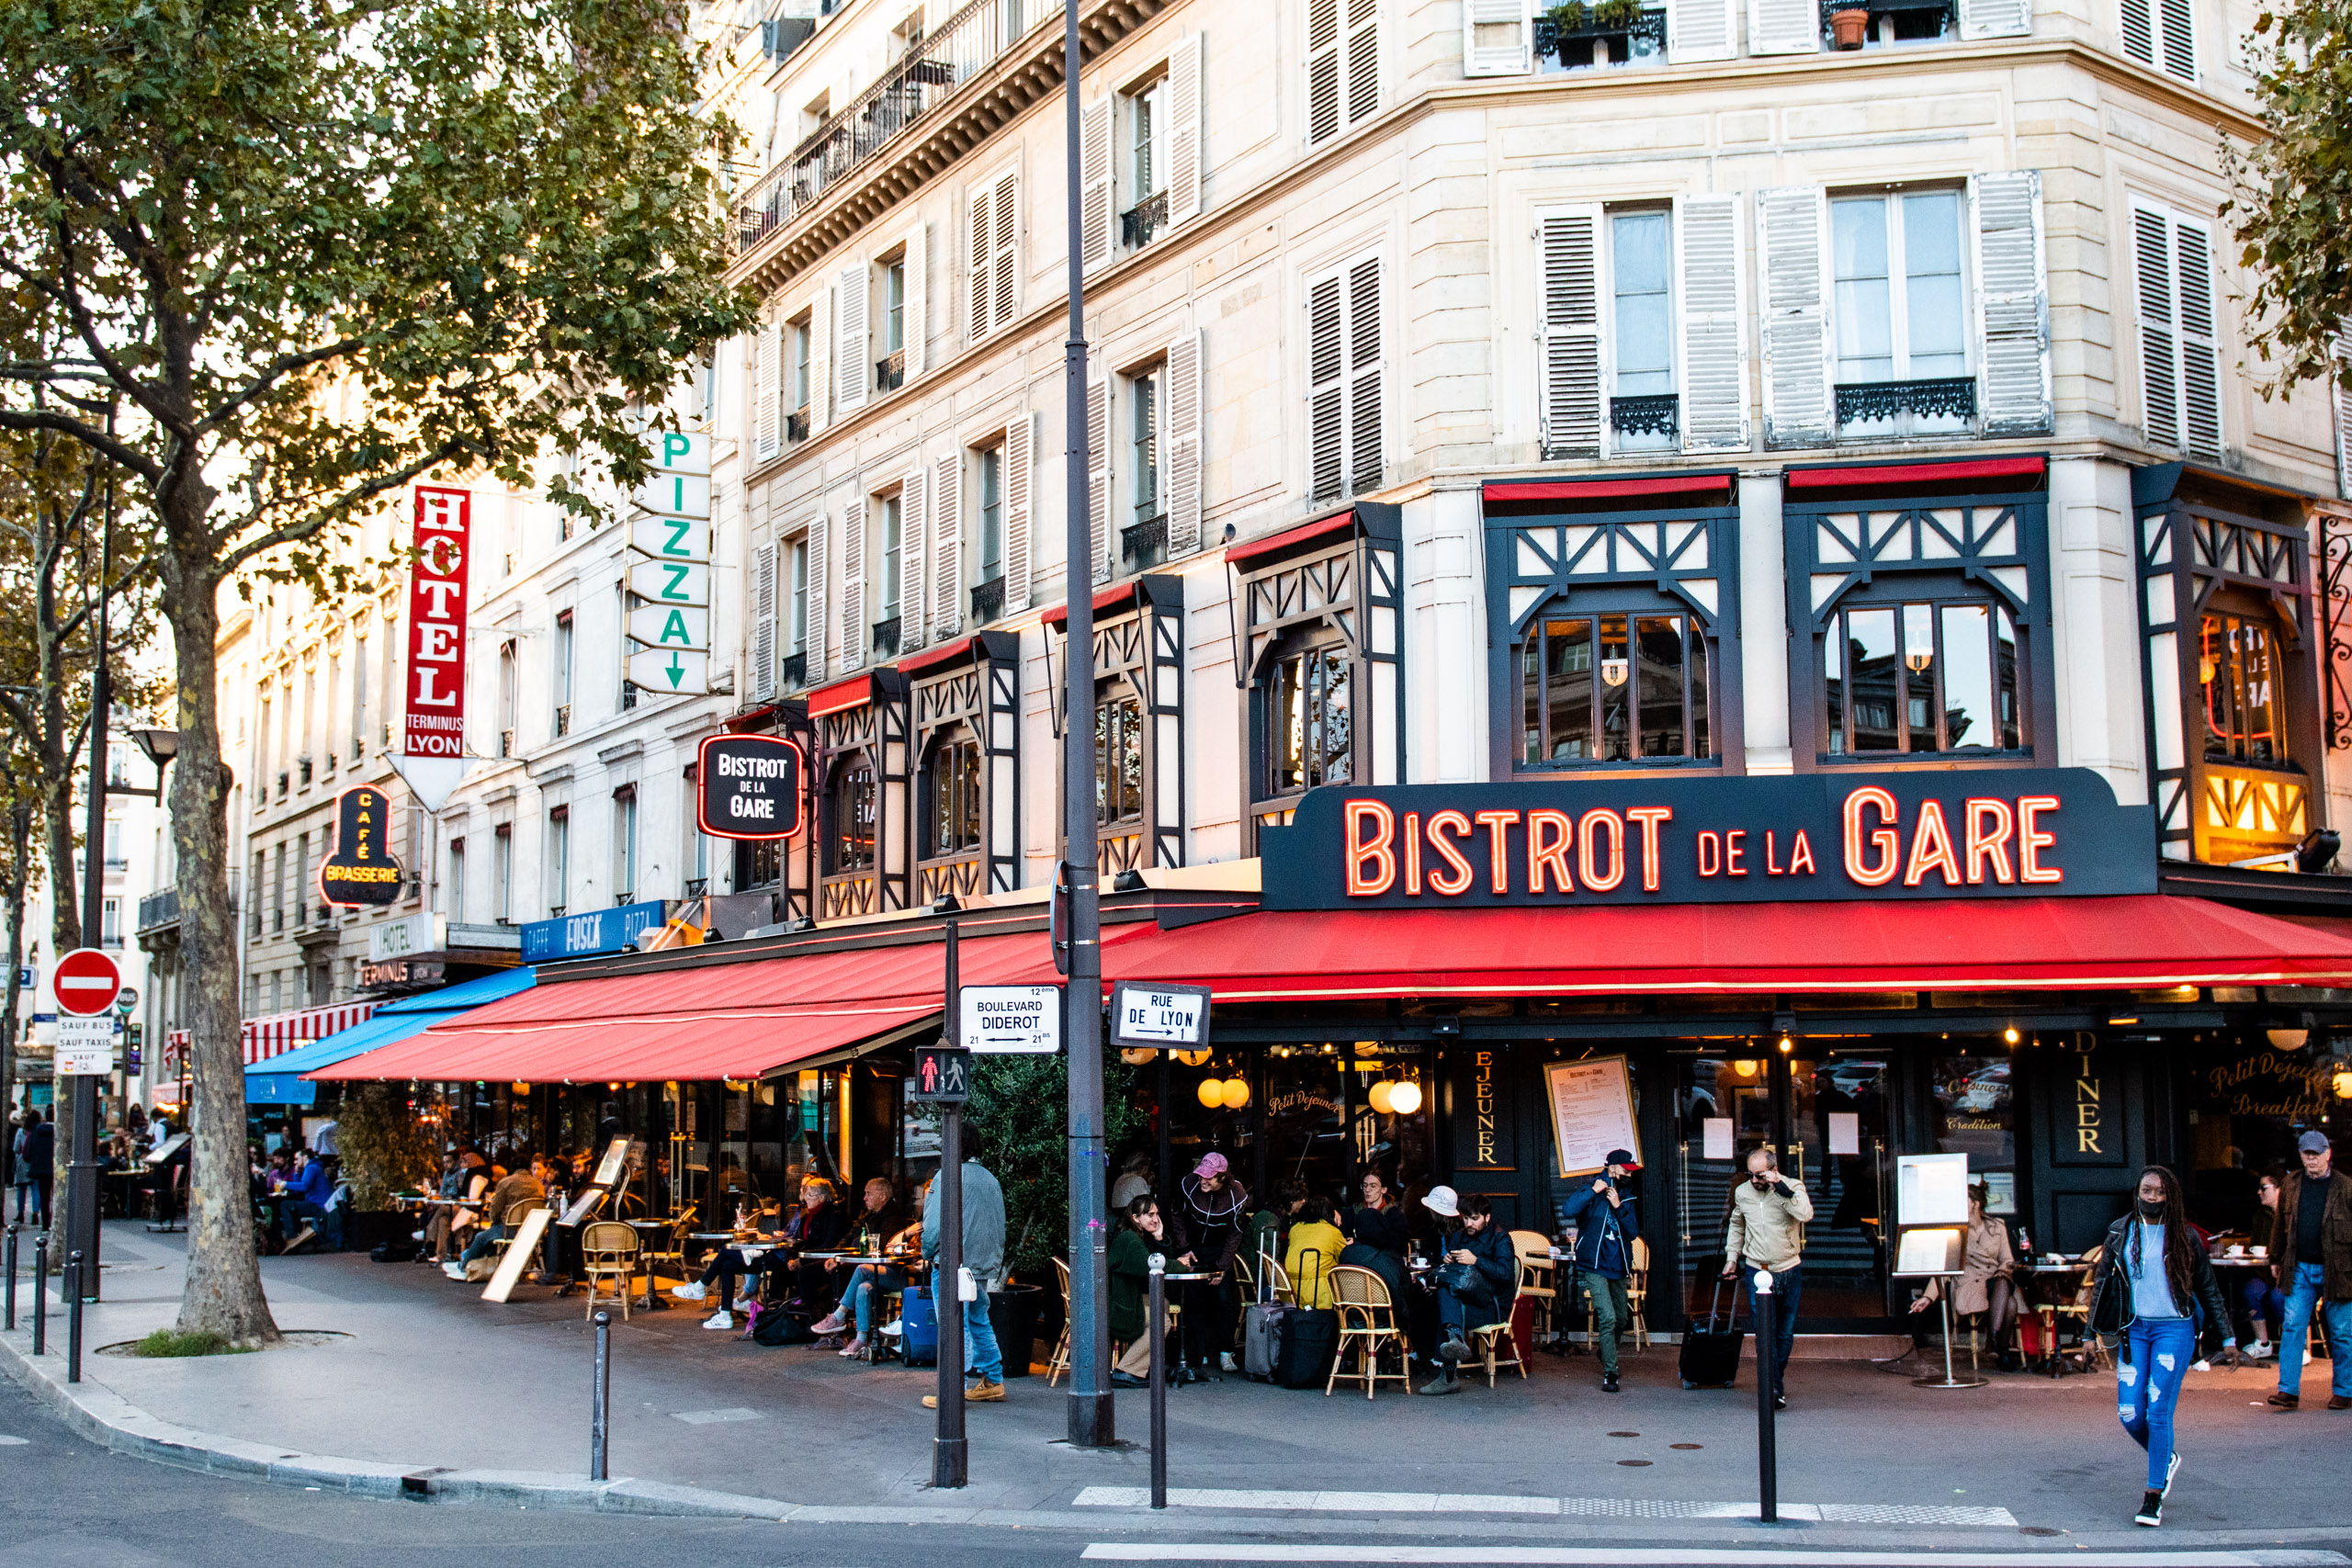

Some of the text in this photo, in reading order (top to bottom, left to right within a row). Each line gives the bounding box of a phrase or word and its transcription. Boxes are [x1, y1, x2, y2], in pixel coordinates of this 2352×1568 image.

[660, 433, 691, 645] PIZZA
[415, 491, 466, 707] HOTEL
[406, 714, 464, 731] TERMINUS
[407, 734, 461, 755] LYON
[718, 753, 787, 779] BISTROT
[740, 781, 766, 794] DE LA
[729, 795, 775, 818] GARE
[356, 793, 372, 860] CAFÉ
[1343, 784, 2064, 897] BISTROT DE LA GARE
[325, 864, 399, 883] BRASSERIE
[382, 924, 411, 953] HOTEL
[359, 962, 408, 987] TERMINUS
[119, 992, 136, 1001] BUS
[977, 1000, 1043, 1011] BOULEVARD
[1150, 995, 1172, 1008] RUE
[62, 1021, 87, 1030] SAUF
[92, 1021, 112, 1030] BUS
[982, 1016, 1040, 1029] DIDEROT
[1129, 1009, 1193, 1027] DE LYON
[60, 1038, 111, 1047] SAUF TAXIS
[970, 1036, 978, 1044] 21
[1033, 1034, 1042, 1043] 21
[1180, 1028, 1184, 1040] 1
[2210, 1056, 2256, 1098] Petit
[2075, 1031, 2102, 1154] DINER
[1268, 1092, 1295, 1117] Petit
[1476, 1051, 1498, 1165] EJEUNER
[2230, 1093, 2330, 1127] Breakfast
[1946, 1116, 2002, 1130] Tradition
